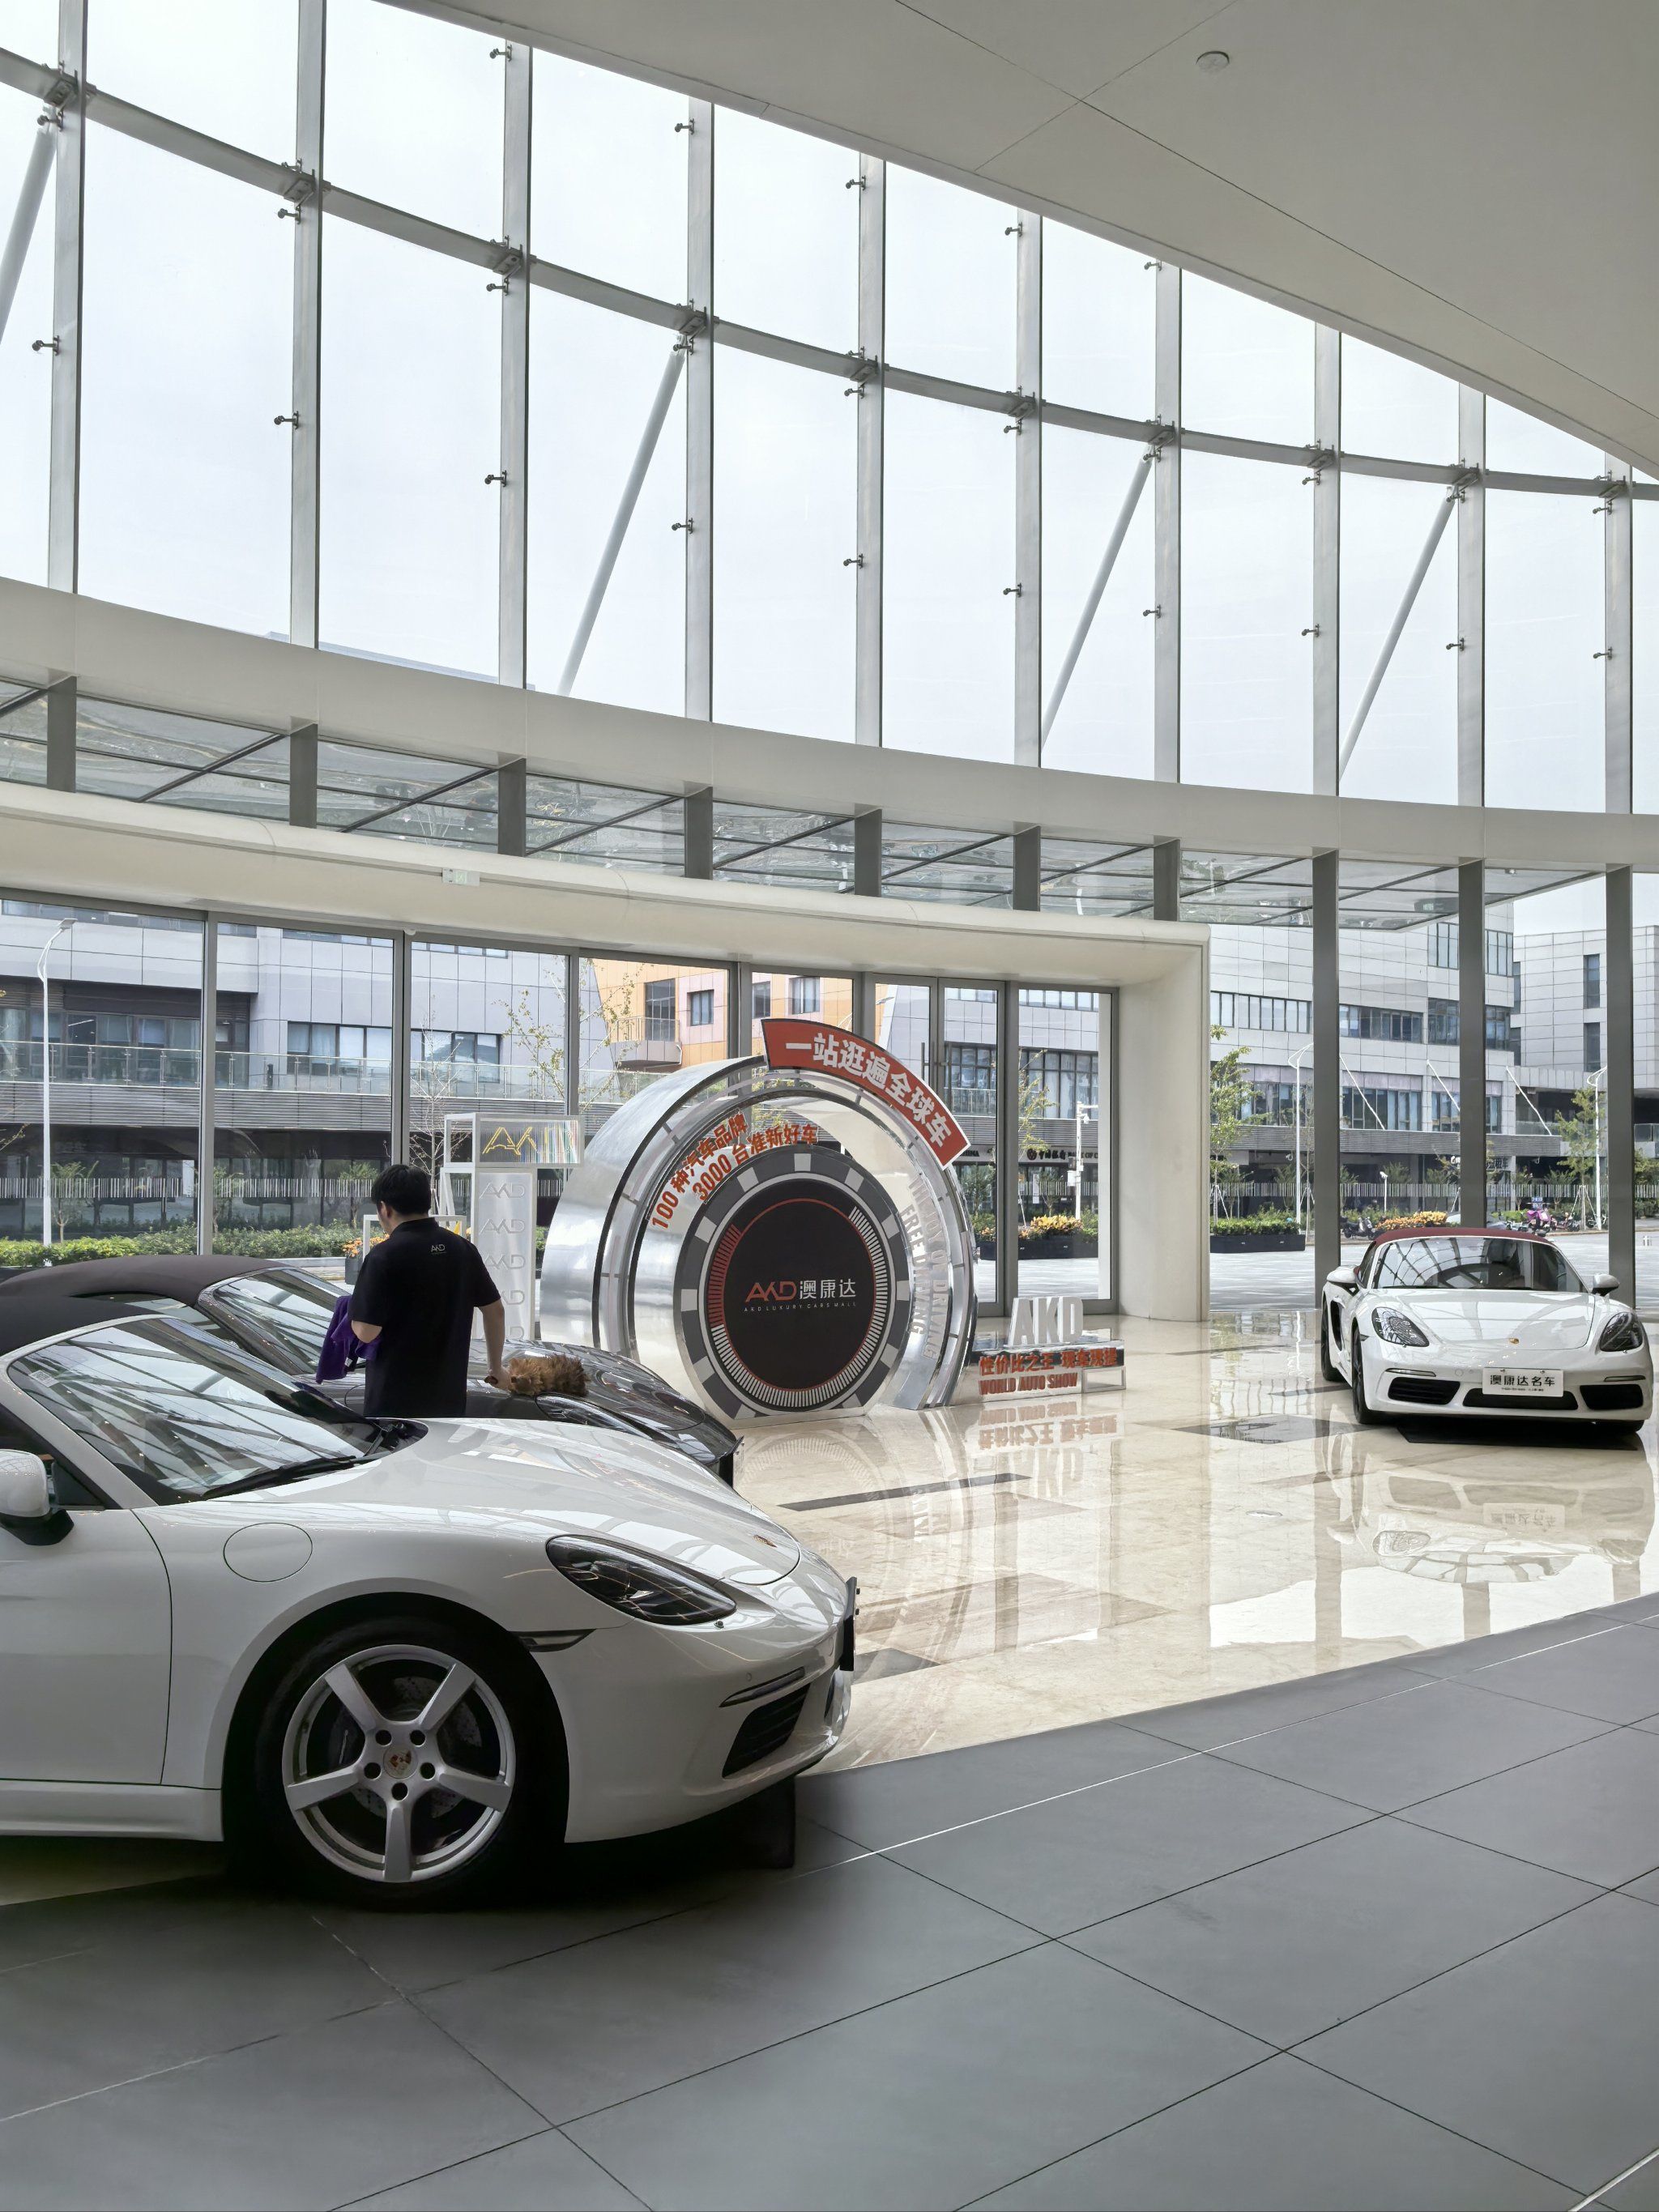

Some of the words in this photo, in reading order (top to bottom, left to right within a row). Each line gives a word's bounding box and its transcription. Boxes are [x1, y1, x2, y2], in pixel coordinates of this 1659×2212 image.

[786, 1033, 951, 1148] 一站逛遍全球车
[652, 1191, 678, 1228] 100
[670, 1113, 748, 1193] 种汽车品牌
[692, 1154, 732, 1200] 3000
[732, 1124, 818, 1165] 台准新好车
[901, 1204, 927, 1252] FREE
[800, 1278, 856, 1299] 澳康达
[1009, 1296, 1083, 1346] AKD
[979, 1353, 1056, 1376] 性价比之王
[979, 1377, 1017, 1395] WORLD
[1017, 1375, 1046, 1392] AUTO
[1047, 1372, 1078, 1388] SHOW
[1490, 1375, 1555, 1387] 澳康达名车
